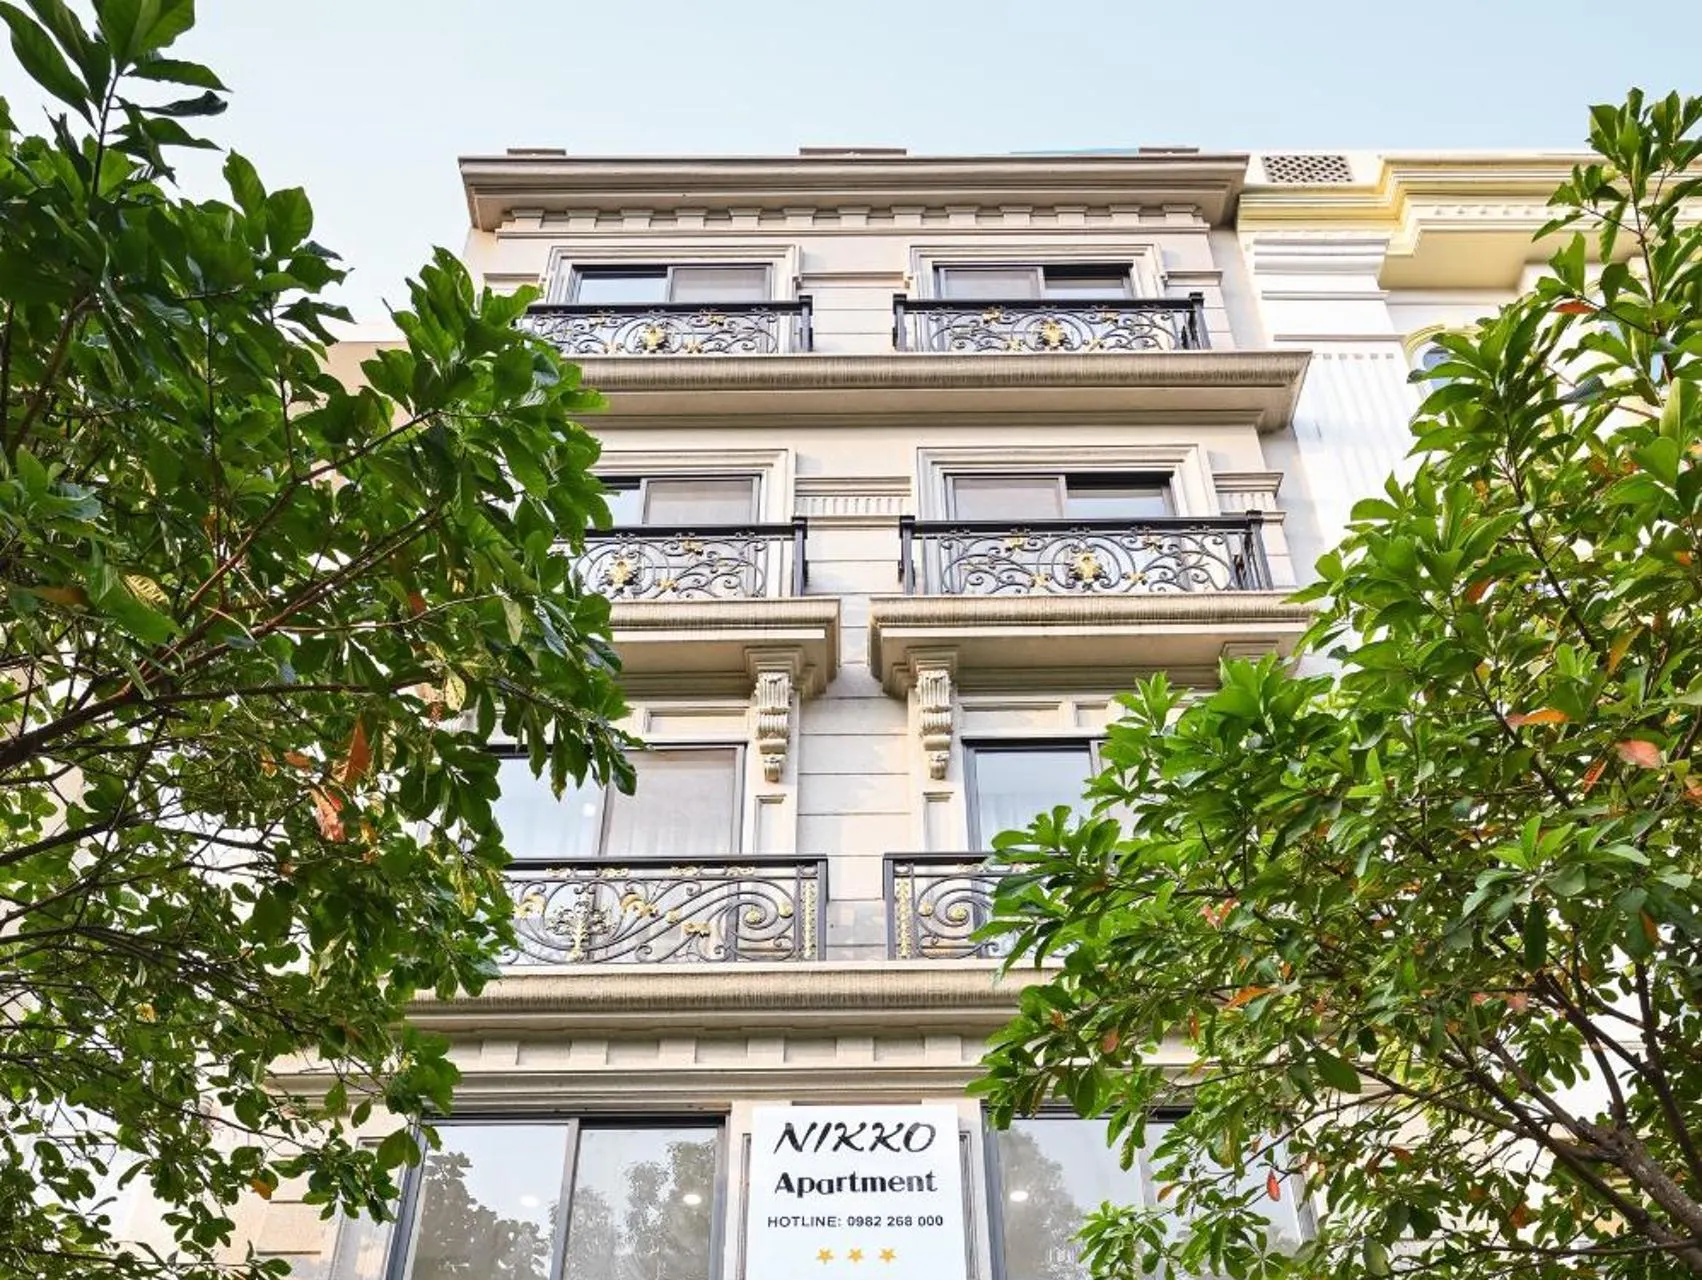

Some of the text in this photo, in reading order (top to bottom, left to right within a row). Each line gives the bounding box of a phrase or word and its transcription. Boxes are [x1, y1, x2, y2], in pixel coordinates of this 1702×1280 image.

[773, 1121, 937, 1154] NIKKO
[774, 1170, 939, 1198] Apartment
[767, 1215, 944, 1227] HOTLINE: 0982 268 000
